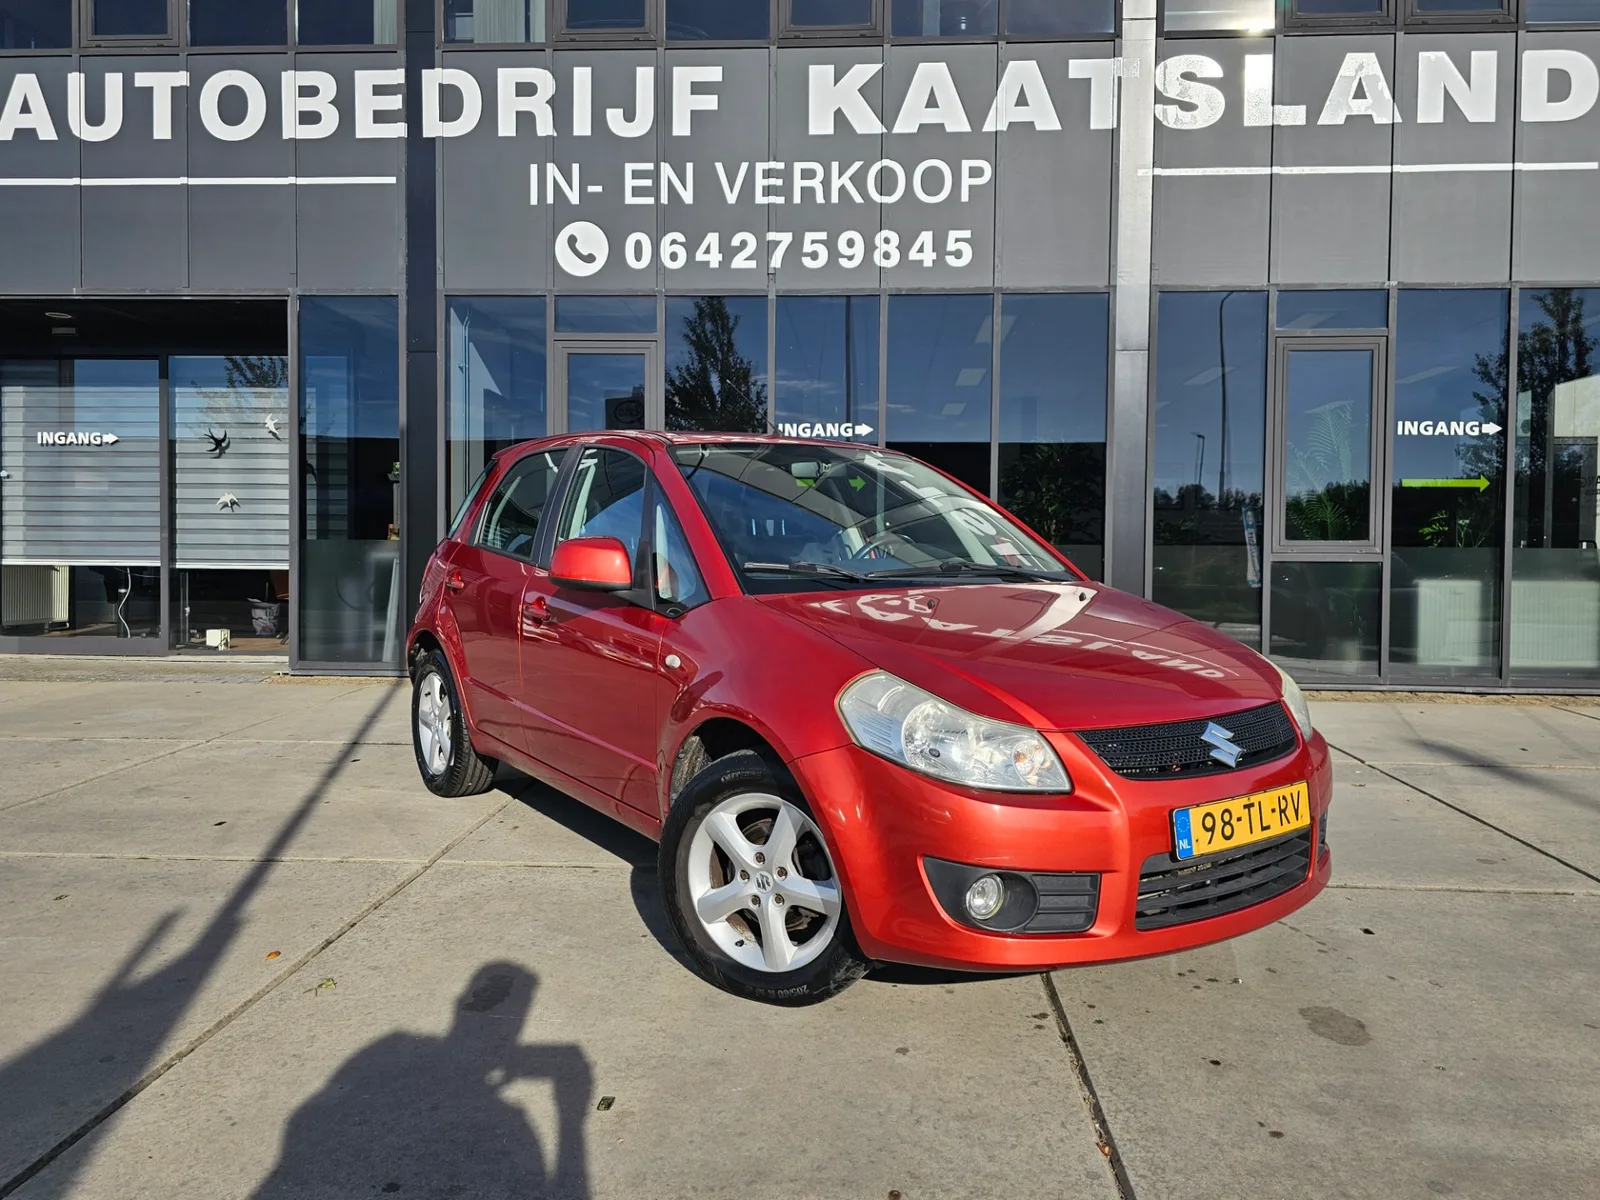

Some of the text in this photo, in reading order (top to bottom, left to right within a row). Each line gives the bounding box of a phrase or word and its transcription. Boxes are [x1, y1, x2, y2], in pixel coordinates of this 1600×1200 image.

[0, 49, 1599, 142] AUTOBEDRIJF KAATSLAND
[529, 158, 993, 206] IN- EN VERKOOP
[624, 229, 974, 270] 0642759845
[37, 431, 102, 445] INGANG
[778, 422, 853, 437] INGANG
[1397, 420, 1480, 436] INGANG
[1201, 790, 1301, 845] 98-TL-RV
[1179, 839, 1192, 850] NL
